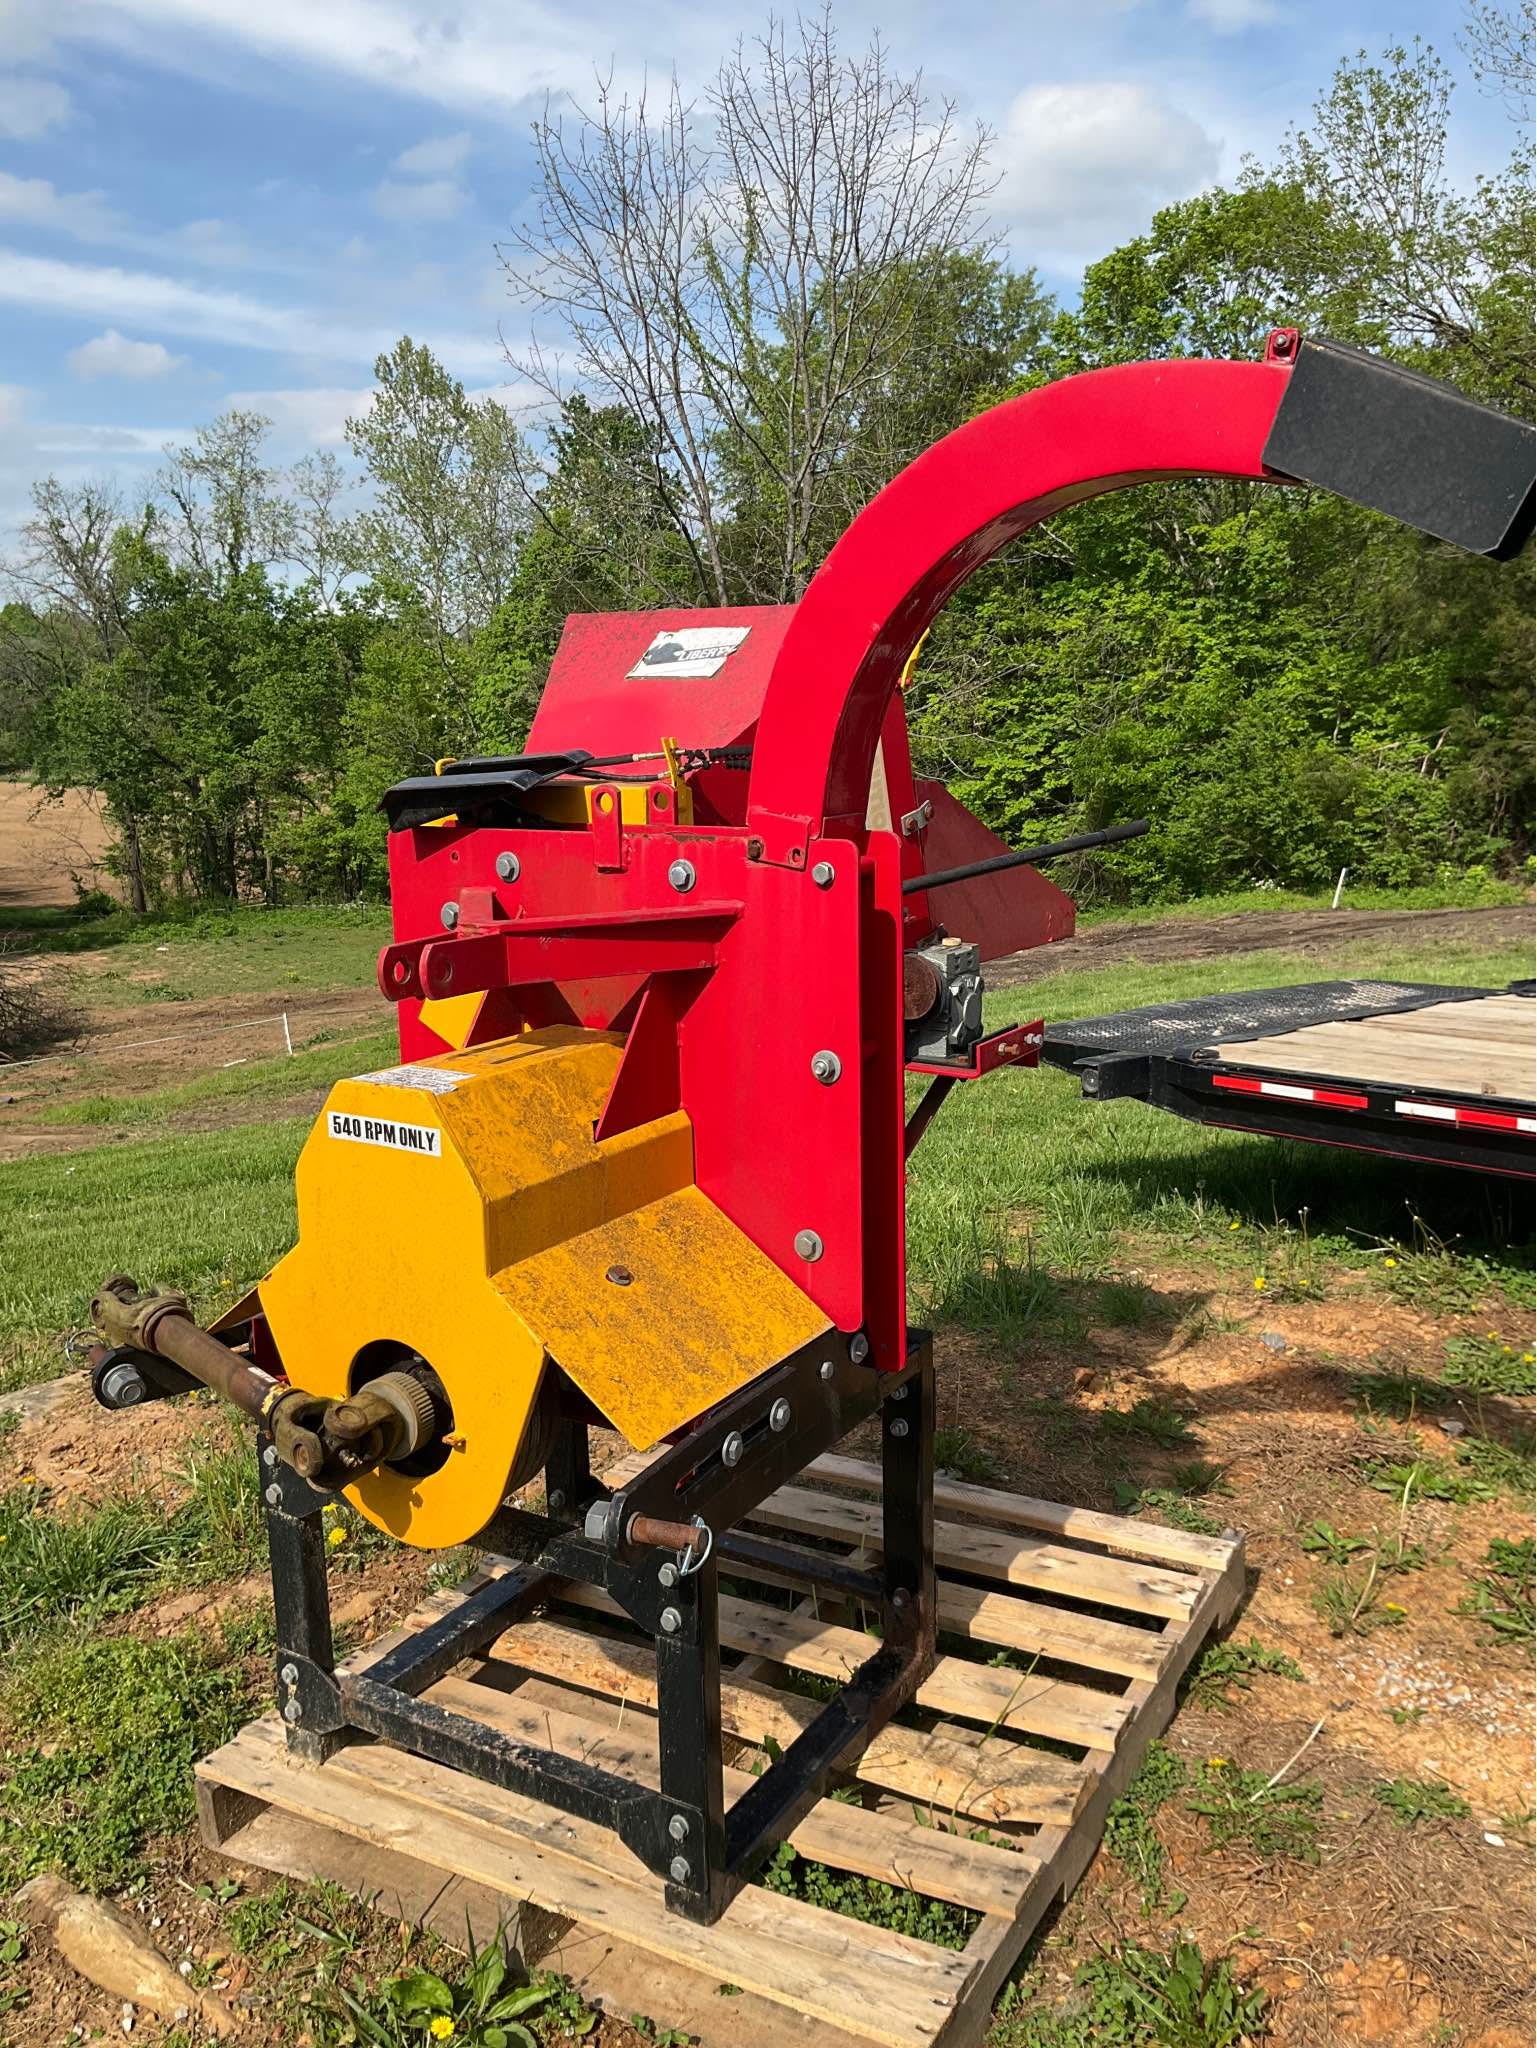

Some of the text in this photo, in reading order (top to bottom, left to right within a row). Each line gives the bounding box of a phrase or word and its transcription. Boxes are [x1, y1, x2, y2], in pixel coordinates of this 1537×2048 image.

[333, 1115, 435, 1151] 540 RPM ONLY
